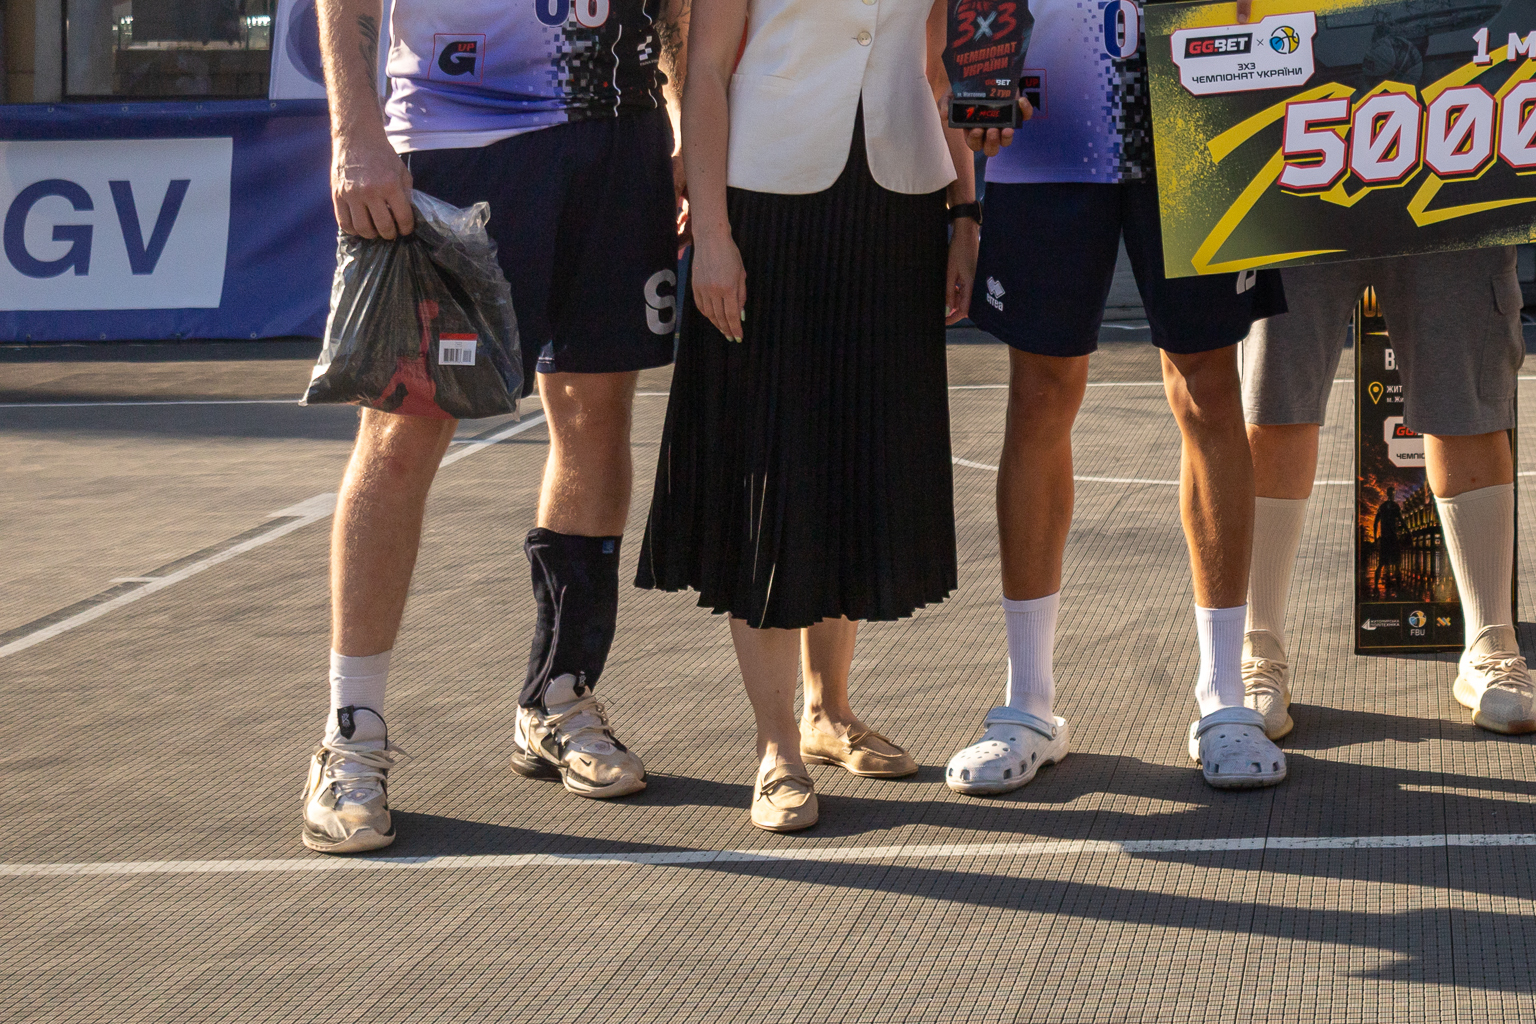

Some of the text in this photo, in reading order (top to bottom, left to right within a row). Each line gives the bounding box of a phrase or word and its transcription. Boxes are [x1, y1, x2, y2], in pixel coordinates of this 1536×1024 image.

[457, 43, 475, 52] UP
[956, 41, 1017, 66] ЧЕМПІОНАТ
[1473, 27, 1493, 66] 1
[963, 56, 1009, 78] УКРАЇНИ
[1192, 67, 1303, 84] ЧЕМПІОНАТ УКРАЇНИ
[1026, 78, 1039, 87] UP
